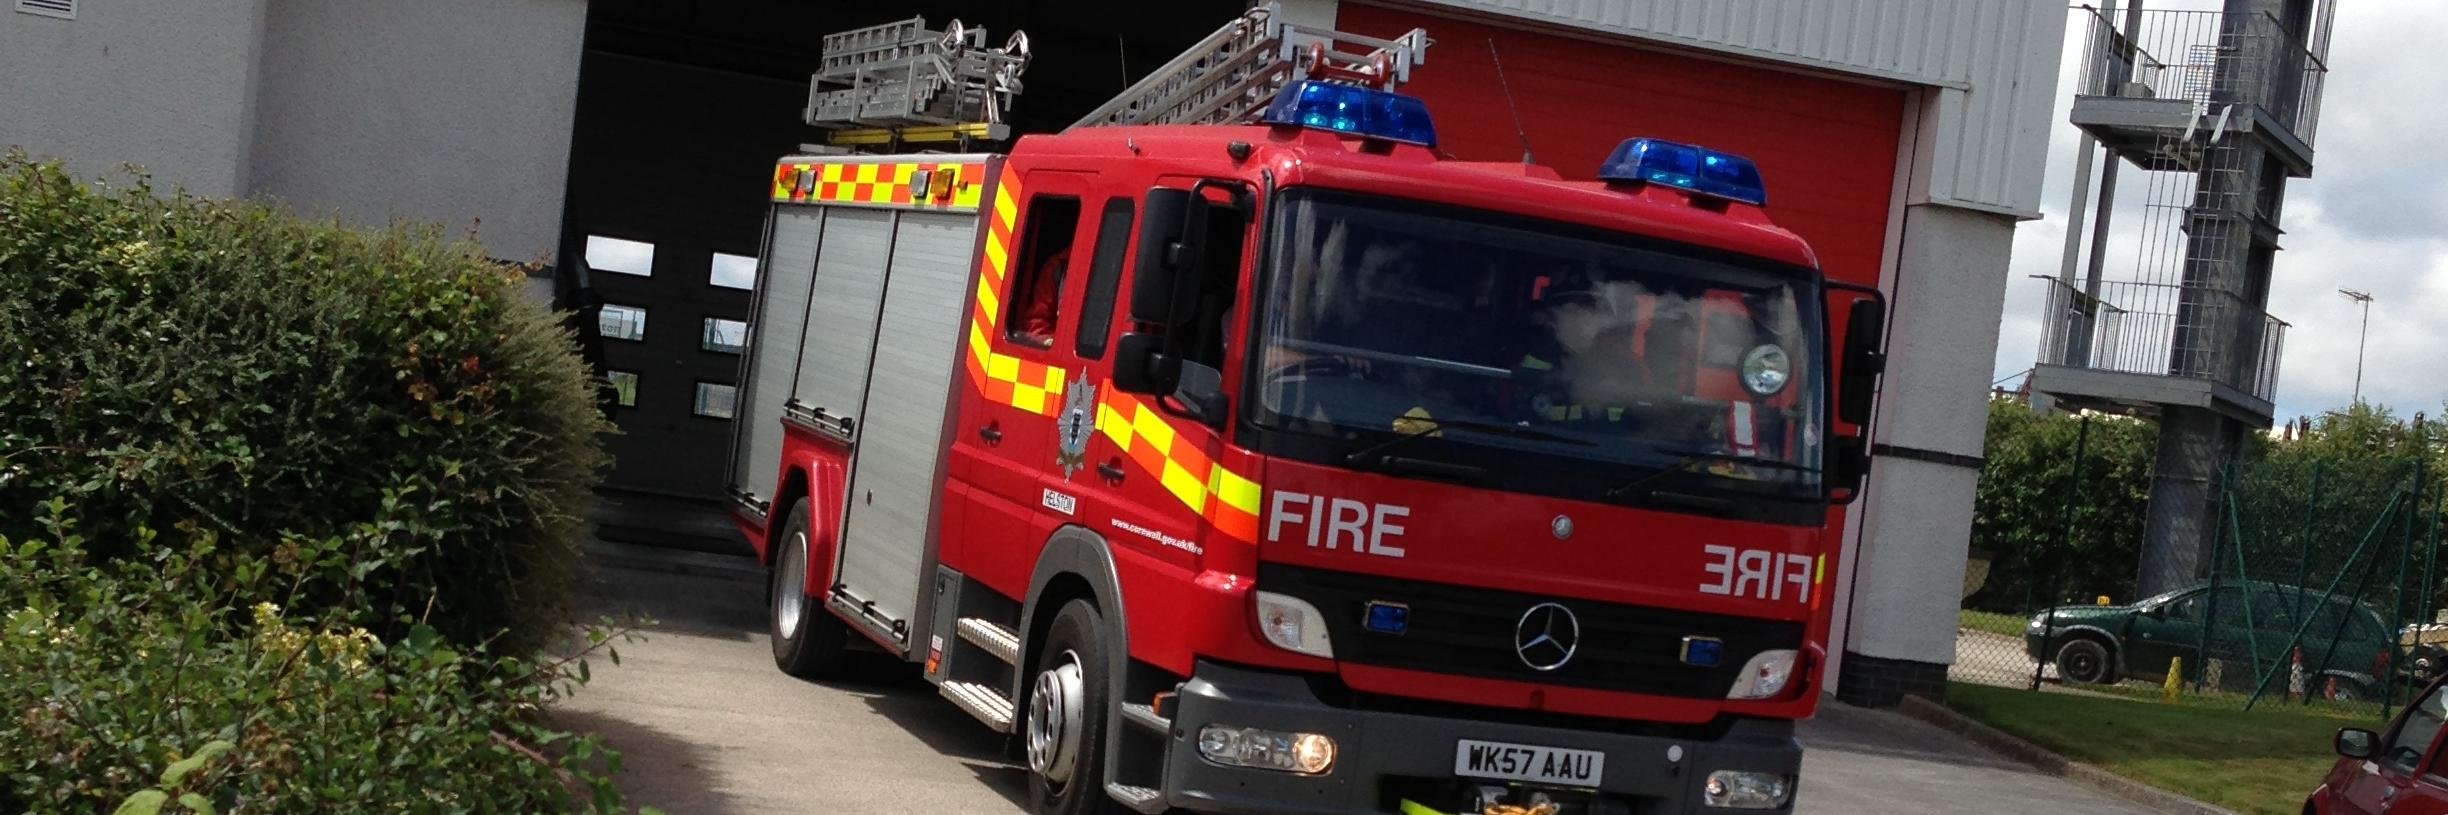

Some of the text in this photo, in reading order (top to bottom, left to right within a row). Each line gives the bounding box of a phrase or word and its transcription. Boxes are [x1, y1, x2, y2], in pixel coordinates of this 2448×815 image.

[1112, 518, 1203, 555] www.cornwall.gov.uk/fire
[1267, 490, 1410, 558] FIRE
[1468, 744, 1592, 780] WK57 AAU
